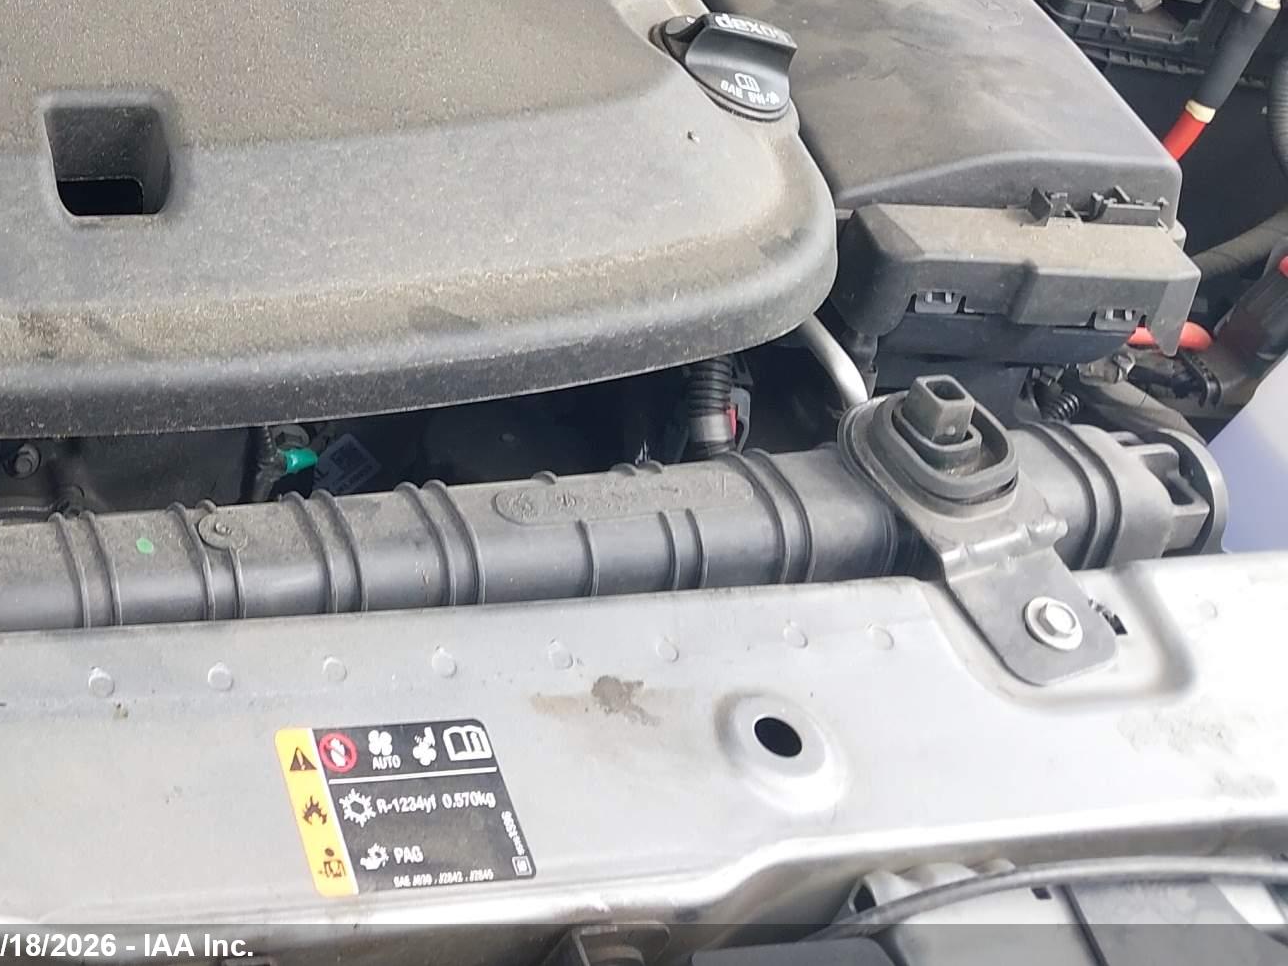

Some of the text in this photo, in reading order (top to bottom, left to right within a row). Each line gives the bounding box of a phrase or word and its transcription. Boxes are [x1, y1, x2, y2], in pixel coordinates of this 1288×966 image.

[720, 79, 744, 100] SAE
[372, 754, 402, 770] AUTO
[376, 791, 497, 815] R-1234yf 0.570kg
[393, 845, 424, 864] PAG
